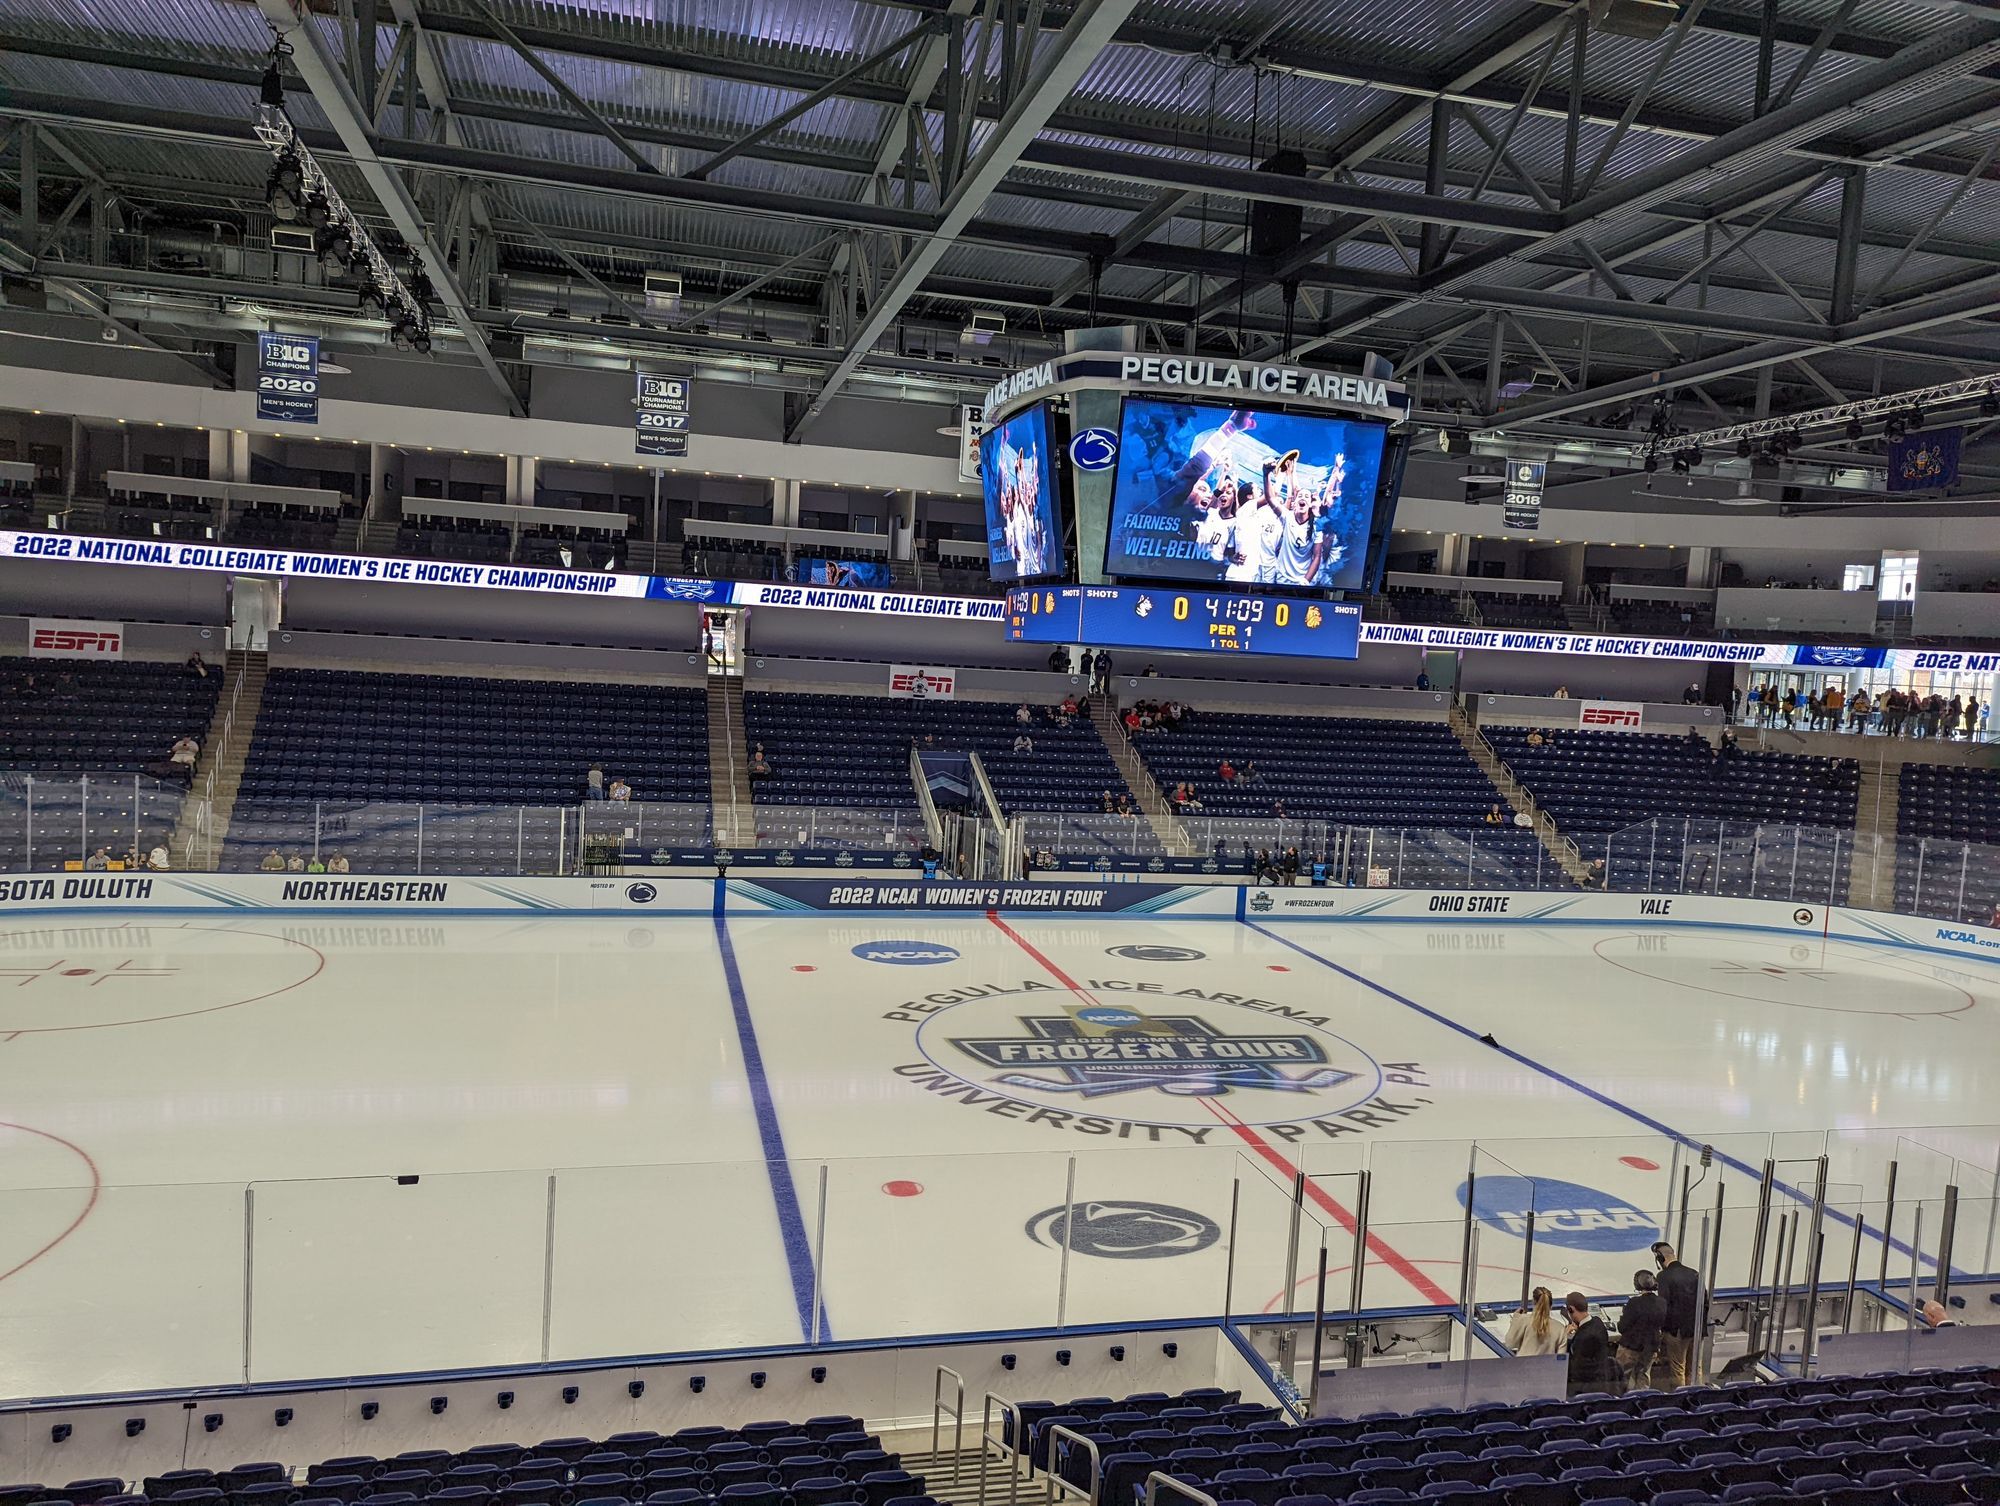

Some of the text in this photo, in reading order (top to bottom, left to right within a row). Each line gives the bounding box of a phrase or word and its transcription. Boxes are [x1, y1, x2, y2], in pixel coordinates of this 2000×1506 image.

[266, 360, 310, 370] CHAMPIONS
[260, 376, 316, 393] 2020
[994, 362, 1054, 405] ICE ARENA
[1121, 356, 1389, 408] PEGULA ICE ARENA
[263, 398, 313, 409] MEN'S HOCKEY
[641, 396, 685, 406] TOURNAMENT
[644, 402, 682, 410] CHAMPIONS
[640, 414, 684, 428] 2017
[1506, 494, 1540, 505] 2018
[1125, 536, 1214, 560] WELL-BEING
[14, 536, 616, 593] 2022 NATIONAL COLLEGIATE WOMEN'S ICE HOCKEY CHAMPIONSHIP
[760, 587, 802, 604] 2022
[806, 590, 875, 610] NATIONAL
[880, 596, 962, 616] COLLEGIATE
[1062, 589, 1080, 597] SHOTS
[1086, 590, 1118, 598] SHOTS
[1174, 596, 1289, 627] 0 41:09 0
[1334, 606, 1358, 615] SHOTS
[1210, 624, 1252, 636] PER 1
[33, 629, 120, 652] ESPN
[1210, 639, 1249, 649] 1 TOL 1
[1366, 626, 1424, 642] NATIONAL
[1428, 630, 1499, 646] COLLEGIATE
[1501, 633, 1567, 650] WOMEN'S
[1570, 637, 1591, 651] ICE
[1595, 639, 1650, 655] HOCKEY
[1652, 642, 1766, 661] CHAMPIONSHIP
[1914, 652, 1963, 669] 2022
[1582, 708, 1640, 726] ESPN
[62, 879, 153, 899] DULUTH
[282, 881, 448, 902] NORTHEASTERN
[829, 887, 1104, 906] 2022 NCAA WOMEN'S FROZEN FOUR
[1284, 900, 1334, 908] #WFROZENFOUR
[1429, 896, 1510, 912] OHIO STATE
[1640, 899, 1672, 915] YALE
[867, 951, 960, 959] NCAA
[881, 979, 1331, 1026] PEGULA ICE ARENA
[999, 1042, 1305, 1061] FROZEN FOUR
[892, 1062, 1434, 1145] UNIVERSITY PARK, PA
[1496, 1208, 1659, 1233] NCAA
